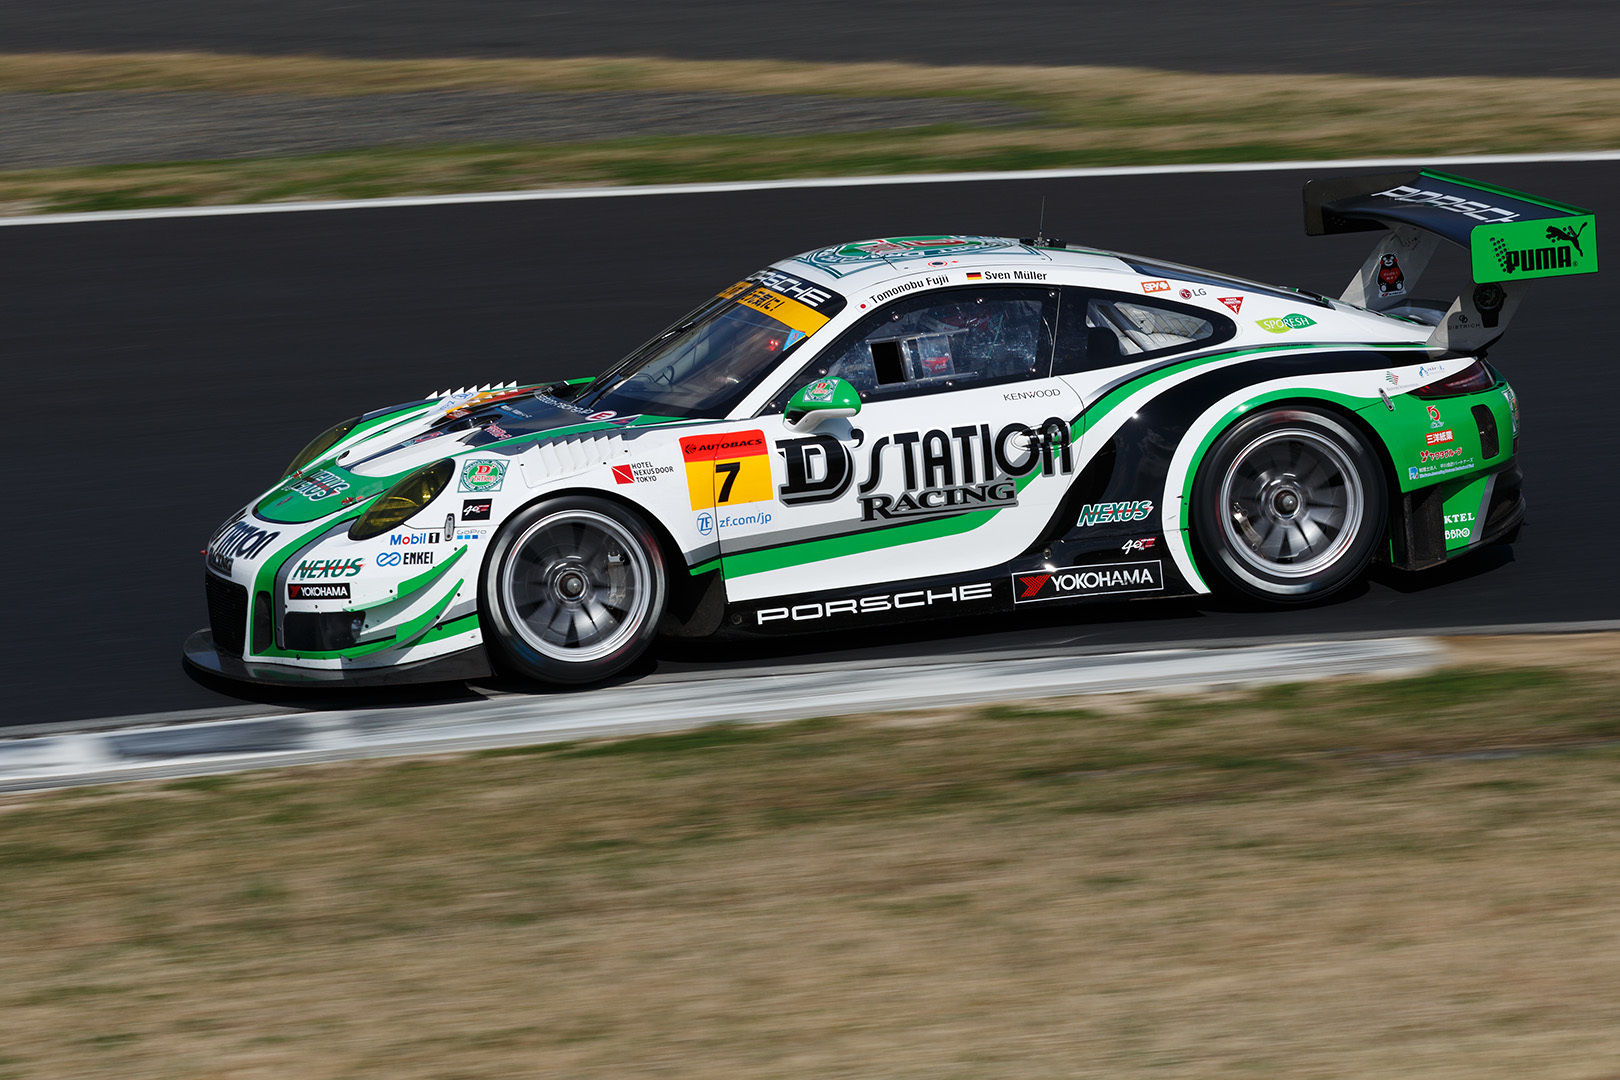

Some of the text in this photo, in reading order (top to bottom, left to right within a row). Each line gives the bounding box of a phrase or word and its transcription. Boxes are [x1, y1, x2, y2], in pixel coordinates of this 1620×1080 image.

[1371, 185, 1520, 223] PORSCH
[1505, 245, 1571, 273] PUMA
[984, 270, 1047, 281] Sven Müller
[869, 274, 949, 304] Tomonobu Fujii
[1192, 288, 1207, 297] LG
[1003, 388, 1061, 401] KENWOOD
[698, 438, 763, 451] AUTOBACS
[631, 461, 653, 470] HOTEL
[635, 475, 658, 483] TOKYO
[715, 461, 741, 504] 7
[859, 482, 1018, 523] RACING
[697, 512, 772, 530] ZF zf.com/jp
[1076, 500, 1153, 526] NEXUS
[389, 532, 440, 546] Mobil 1
[403, 551, 434, 565] ENKEI
[291, 557, 365, 581] NEXUS
[1051, 568, 1153, 591] YOKOHAMA
[300, 585, 349, 597] YOKOHAMA
[756, 582, 993, 625] PORSCHE
